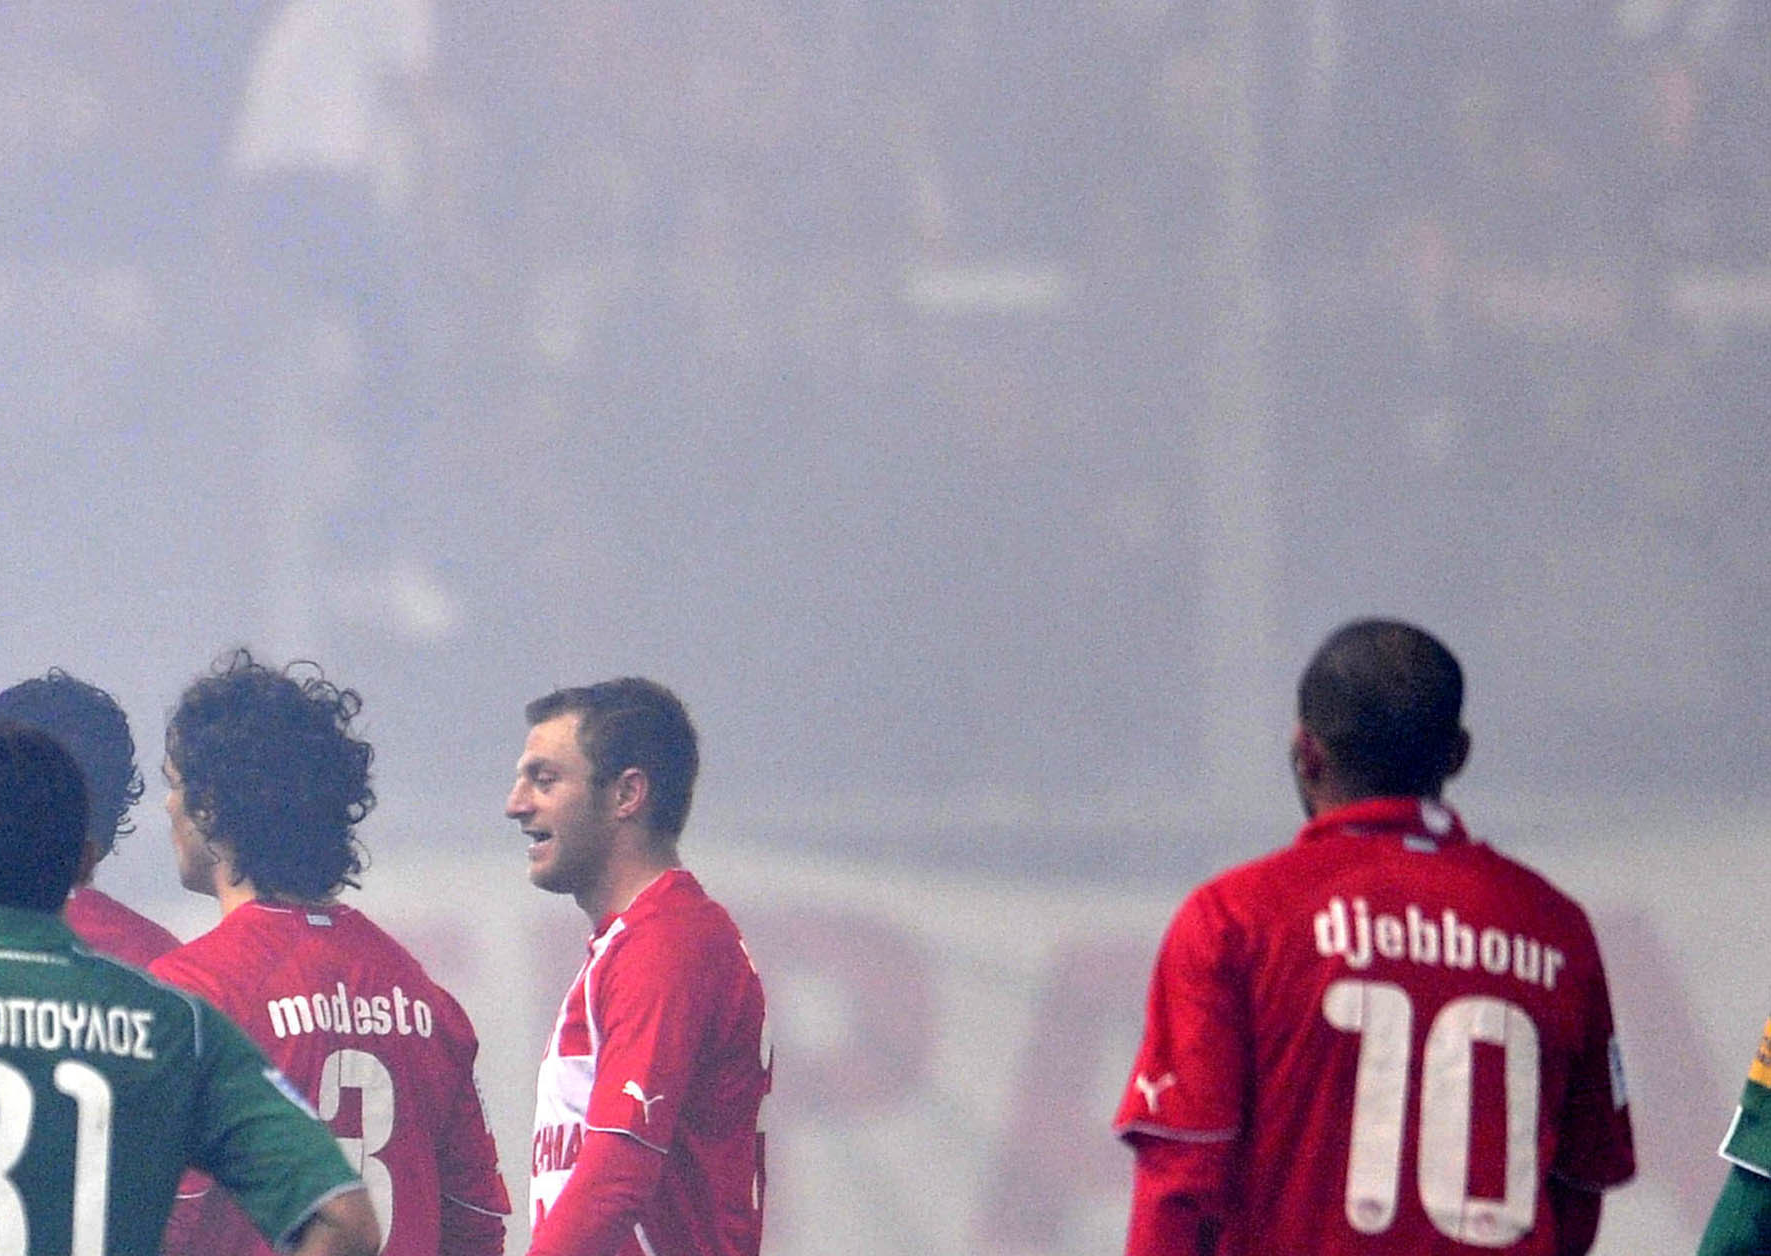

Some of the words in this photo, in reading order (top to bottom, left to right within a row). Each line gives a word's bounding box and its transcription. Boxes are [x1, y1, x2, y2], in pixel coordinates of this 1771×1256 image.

[1314, 897, 1564, 989] djebbour
[267, 981, 432, 1039] modesto
[1322, 981, 1540, 1247] 10
